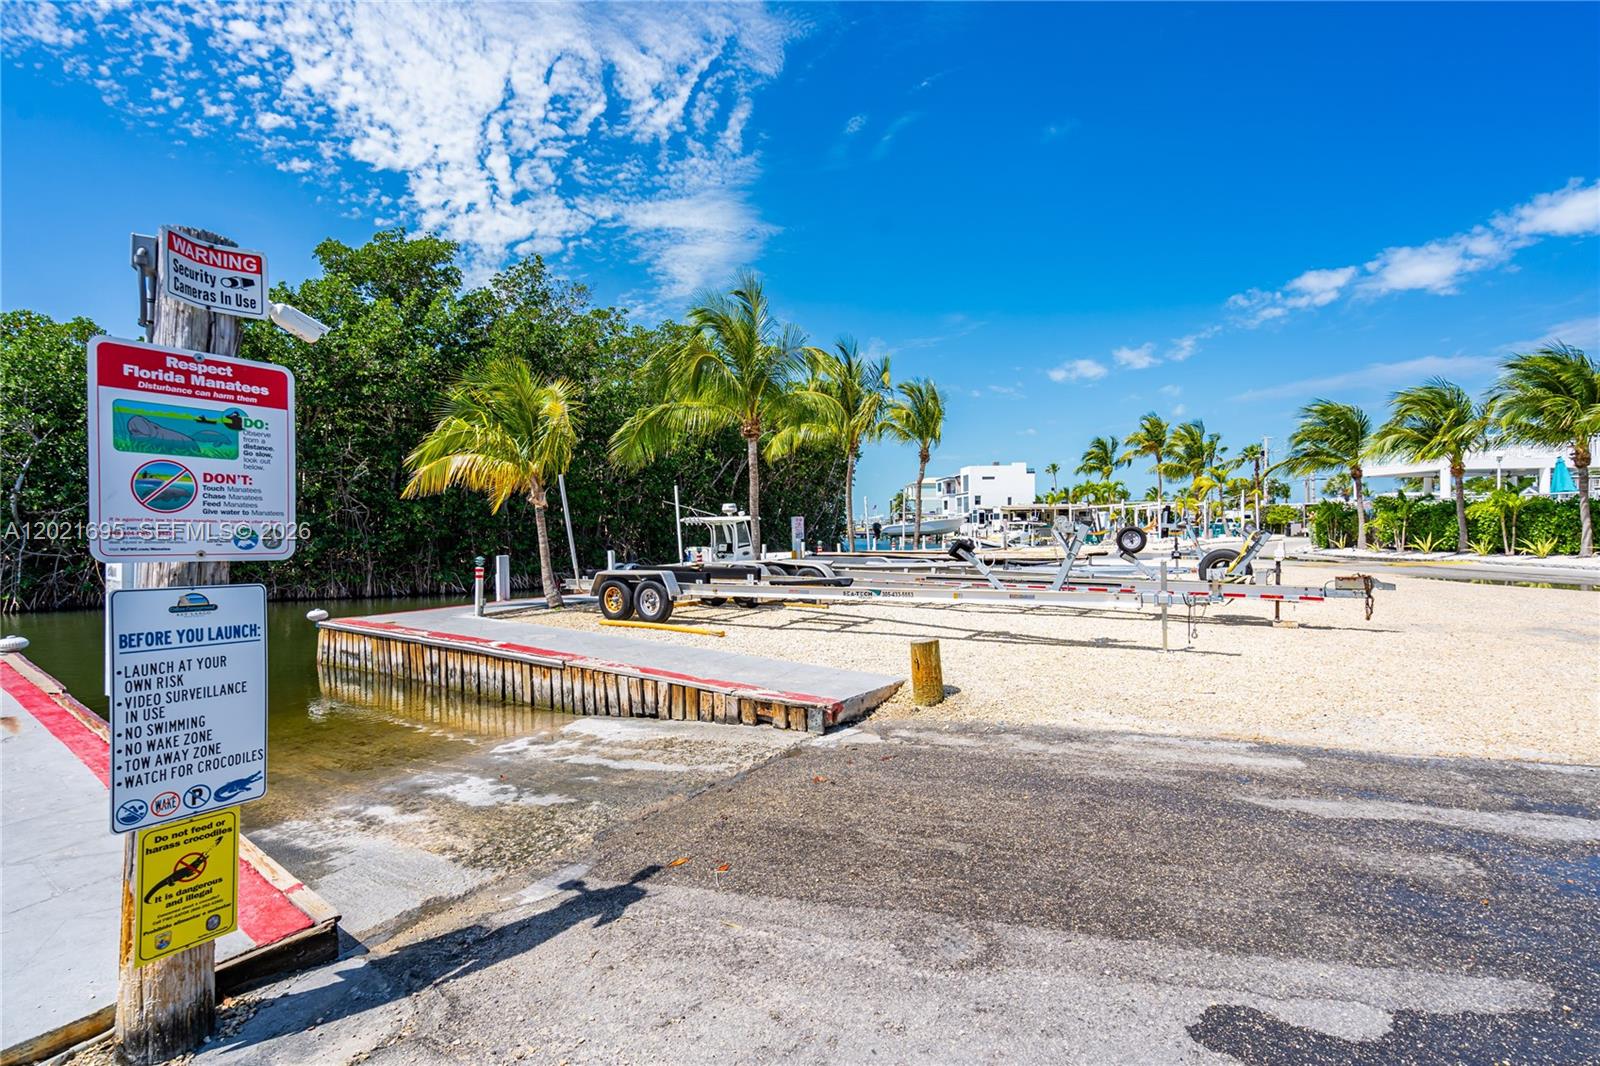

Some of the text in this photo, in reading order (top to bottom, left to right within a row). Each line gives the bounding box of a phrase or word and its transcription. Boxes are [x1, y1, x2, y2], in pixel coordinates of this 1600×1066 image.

[171, 233, 258, 272] WARNING
[173, 257, 217, 288] Security
[173, 276, 257, 309] Cameras In Use
[165, 355, 234, 377] Respect
[122, 363, 270, 396] Florida Manatees
[137, 380, 258, 404] Disturbance can harm them
[242, 430, 272, 439] Observe
[243, 417, 269, 431] DO:
[242, 436, 259, 444] from
[242, 457, 258, 465] look
[255, 451, 273, 460] slow,
[202, 484, 262, 494] Touch Manatees
[202, 492, 264, 502] Chase Manatees
[202, 508, 219, 516] Give
[220, 508, 240, 516] water
[251, 509, 285, 517] Manatees
[223, 501, 259, 509] Manatees
[118, 623, 261, 649] BEFORE YOU LAUNCH:
[124, 655, 227, 679] LAUNCH AT YOUR
[124, 674, 184, 694] OWN RISK
[124, 680, 248, 709] VIDEO SURVEILLANCE
[125, 706, 166, 724] IN USE
[125, 715, 206, 741] NO SWIMMING
[125, 729, 213, 757] NO WAKE ZONE
[124, 742, 222, 773] TOW AWAY ZONE
[124, 748, 264, 789] WATCH FOR CROCODILES
[155, 793, 177, 813] WAKE
[191, 788, 203, 806] P
[145, 826, 233, 856] harass crocodiles
[154, 819, 226, 844] Do not feed or
[154, 895, 162, 904] It
[175, 877, 223, 897] dangerous
[165, 887, 213, 909] and illegal
